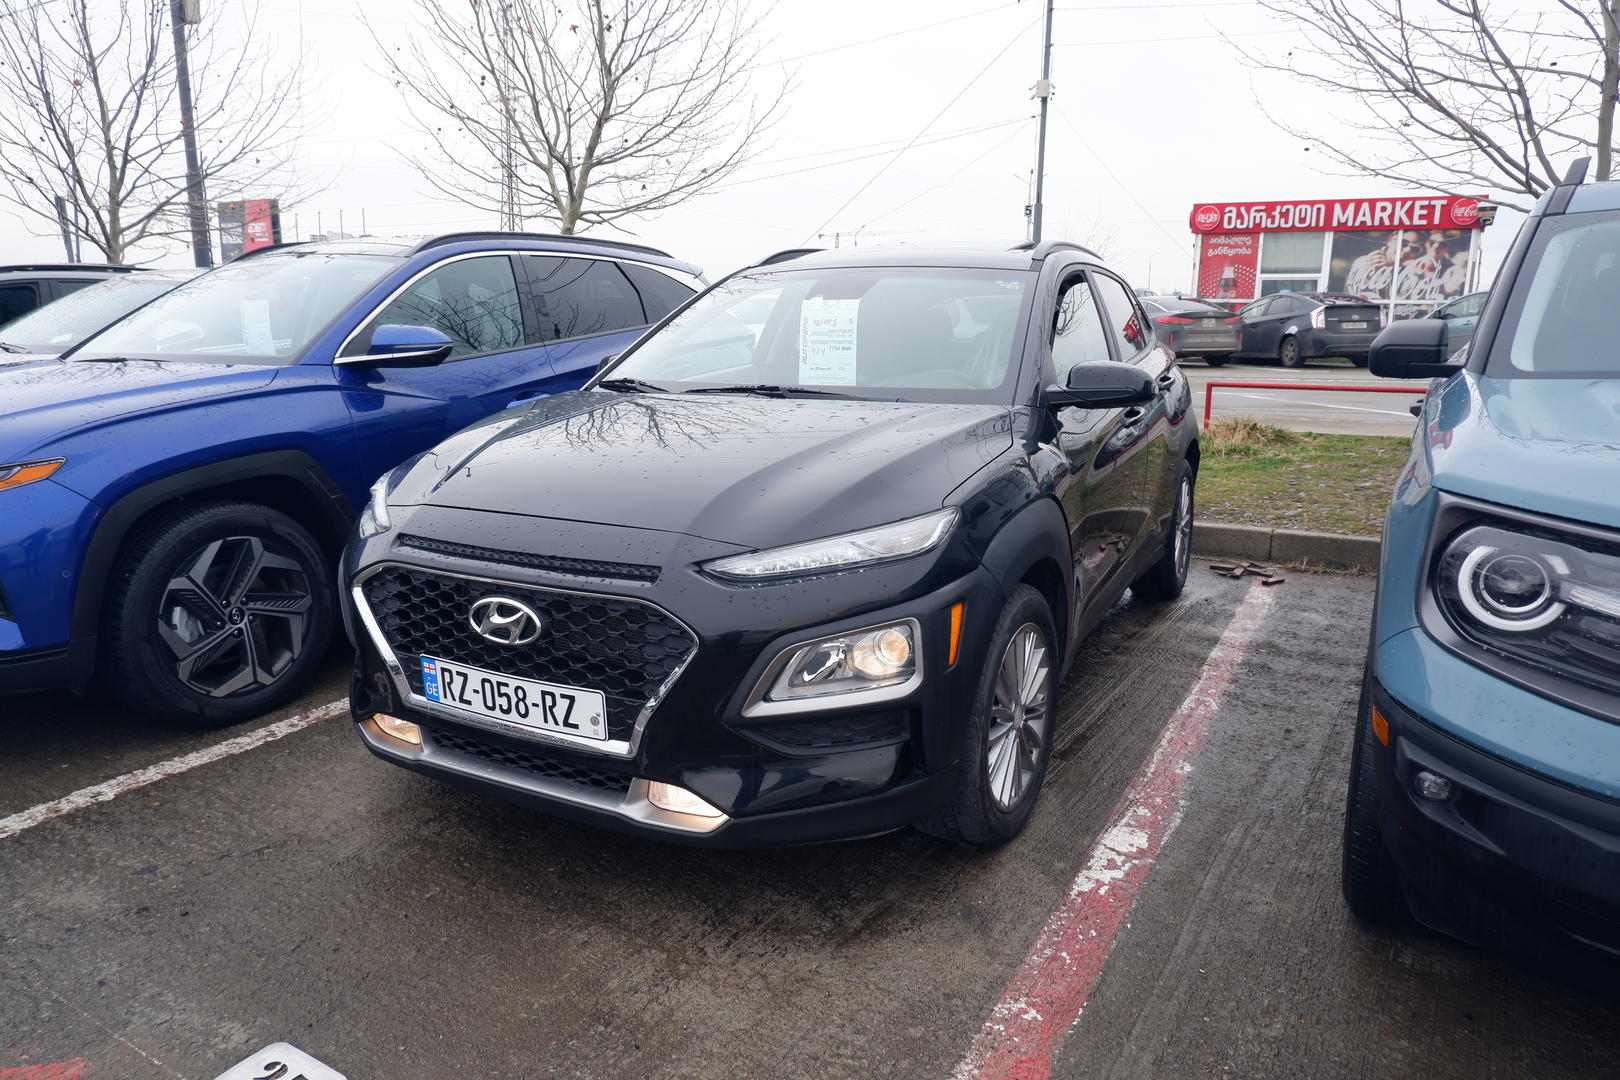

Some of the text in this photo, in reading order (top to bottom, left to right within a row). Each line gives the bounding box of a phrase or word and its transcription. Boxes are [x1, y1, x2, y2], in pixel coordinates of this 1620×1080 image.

[1332, 200, 1447, 227] MARKET
[425, 682, 440, 697] GE
[440, 666, 580, 730] RZ-058-RZ
